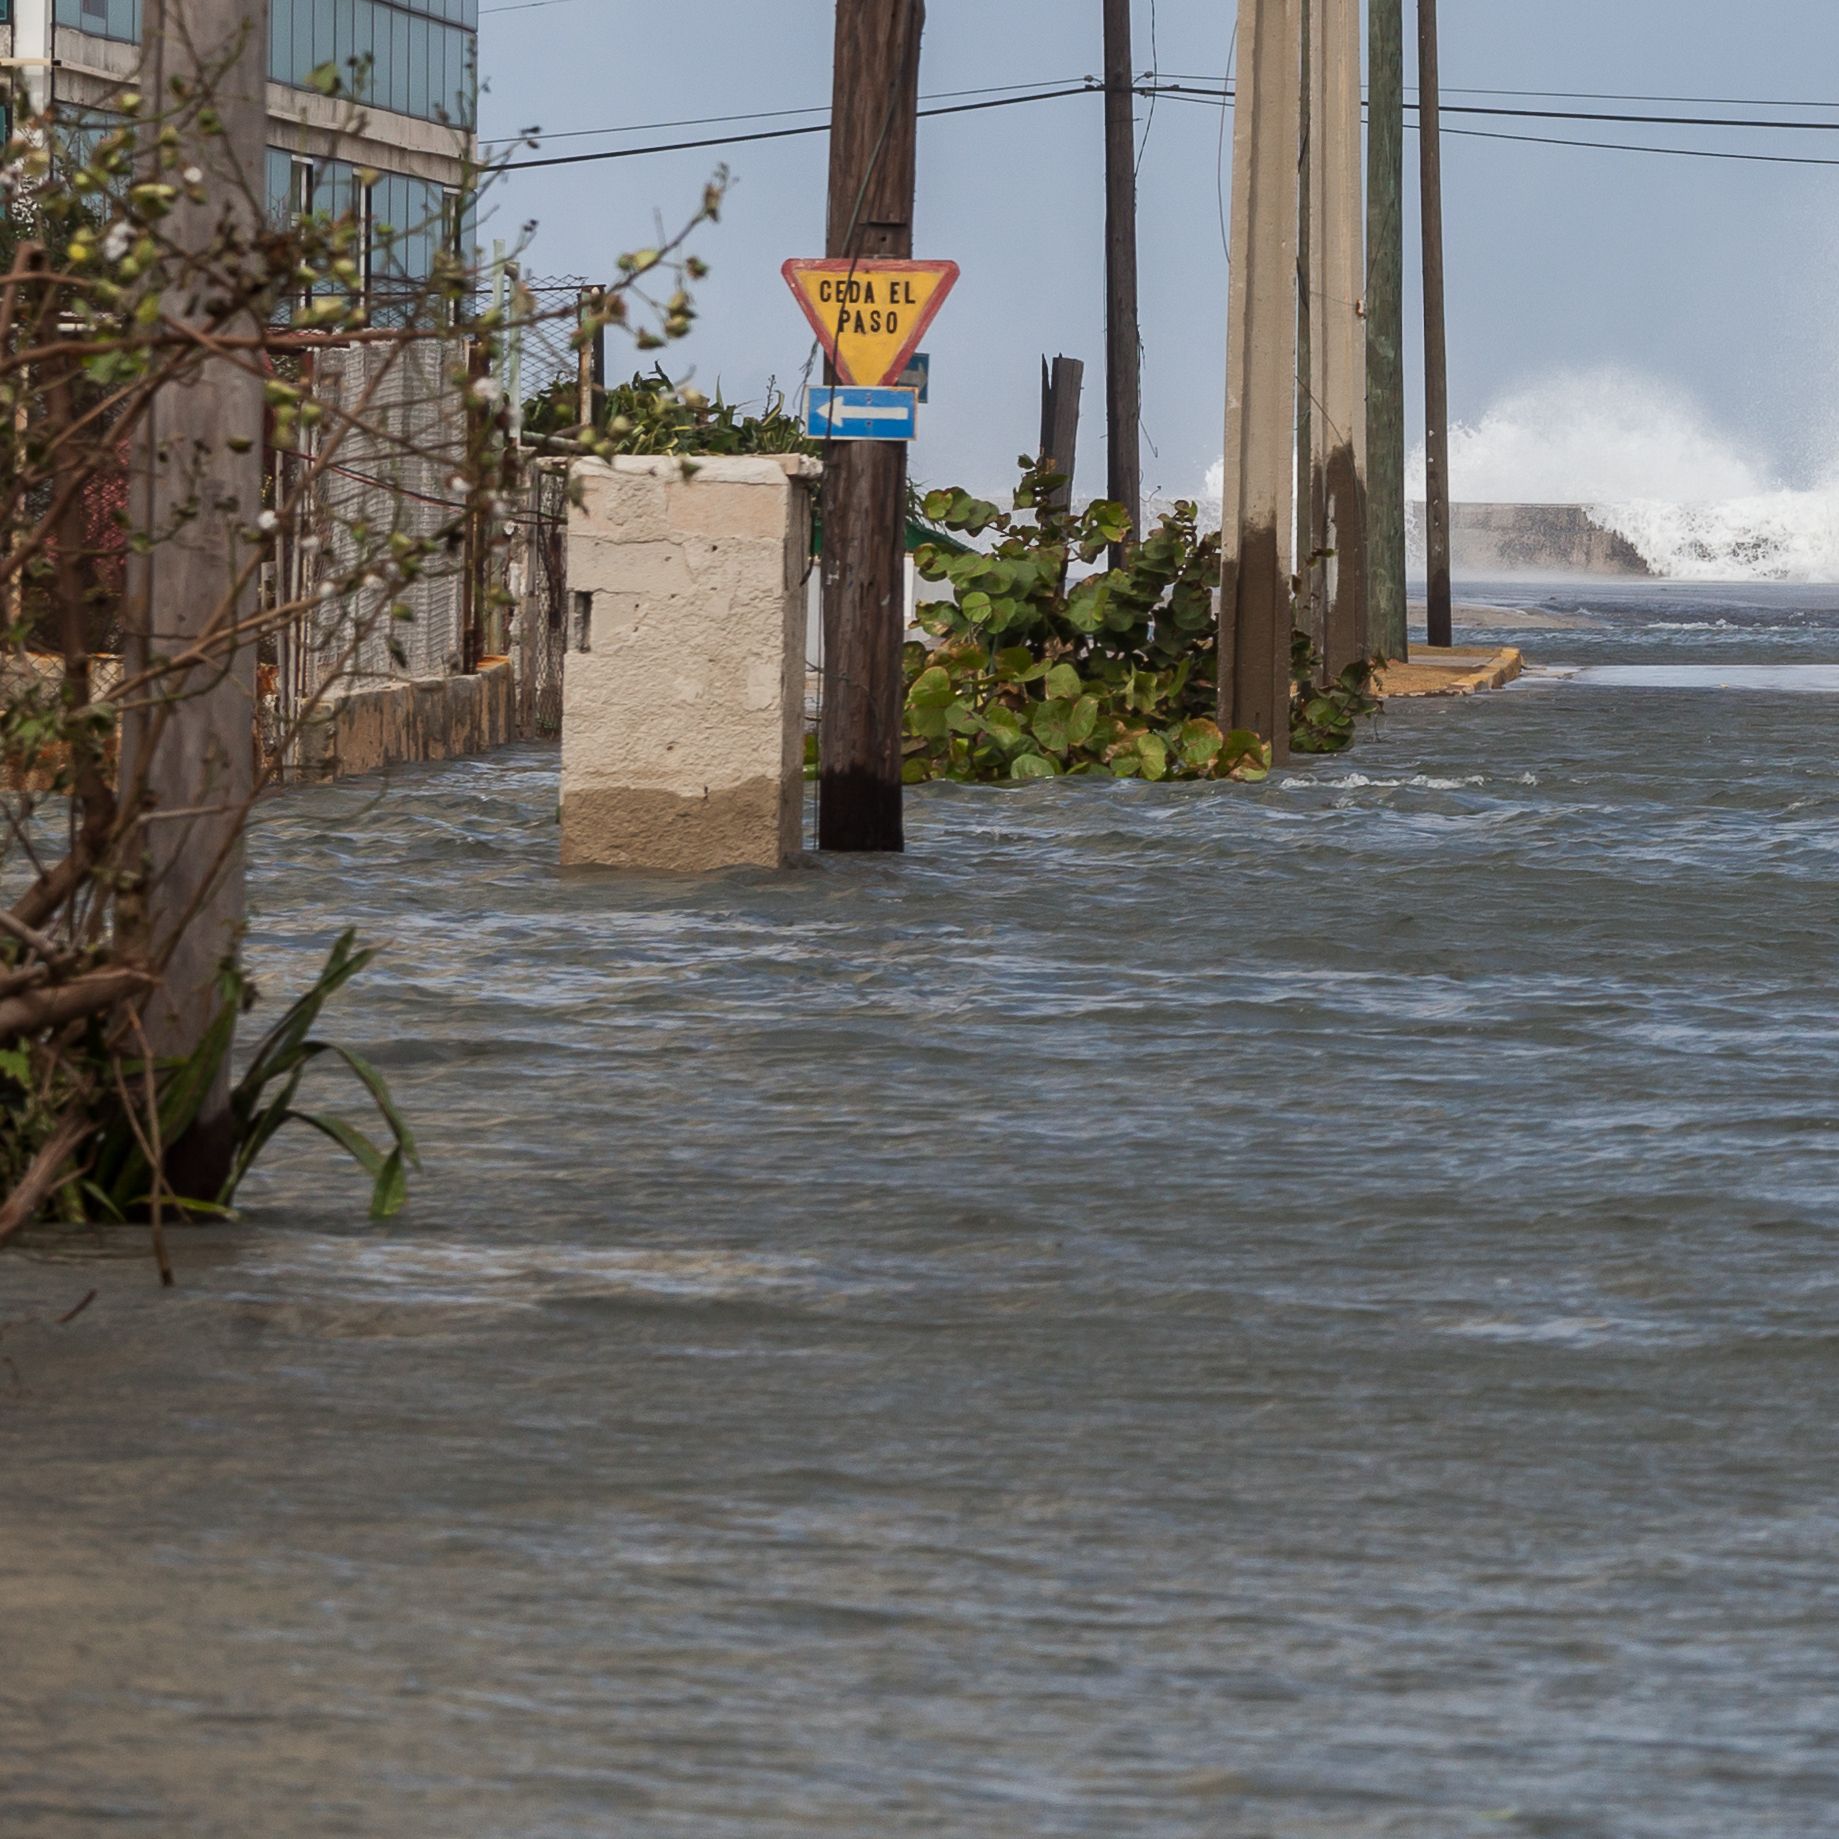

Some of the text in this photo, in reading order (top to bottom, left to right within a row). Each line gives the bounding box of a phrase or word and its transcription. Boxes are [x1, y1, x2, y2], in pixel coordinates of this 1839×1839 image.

[819, 280, 915, 304] CEDA EL
[839, 310, 898, 334] PASO
